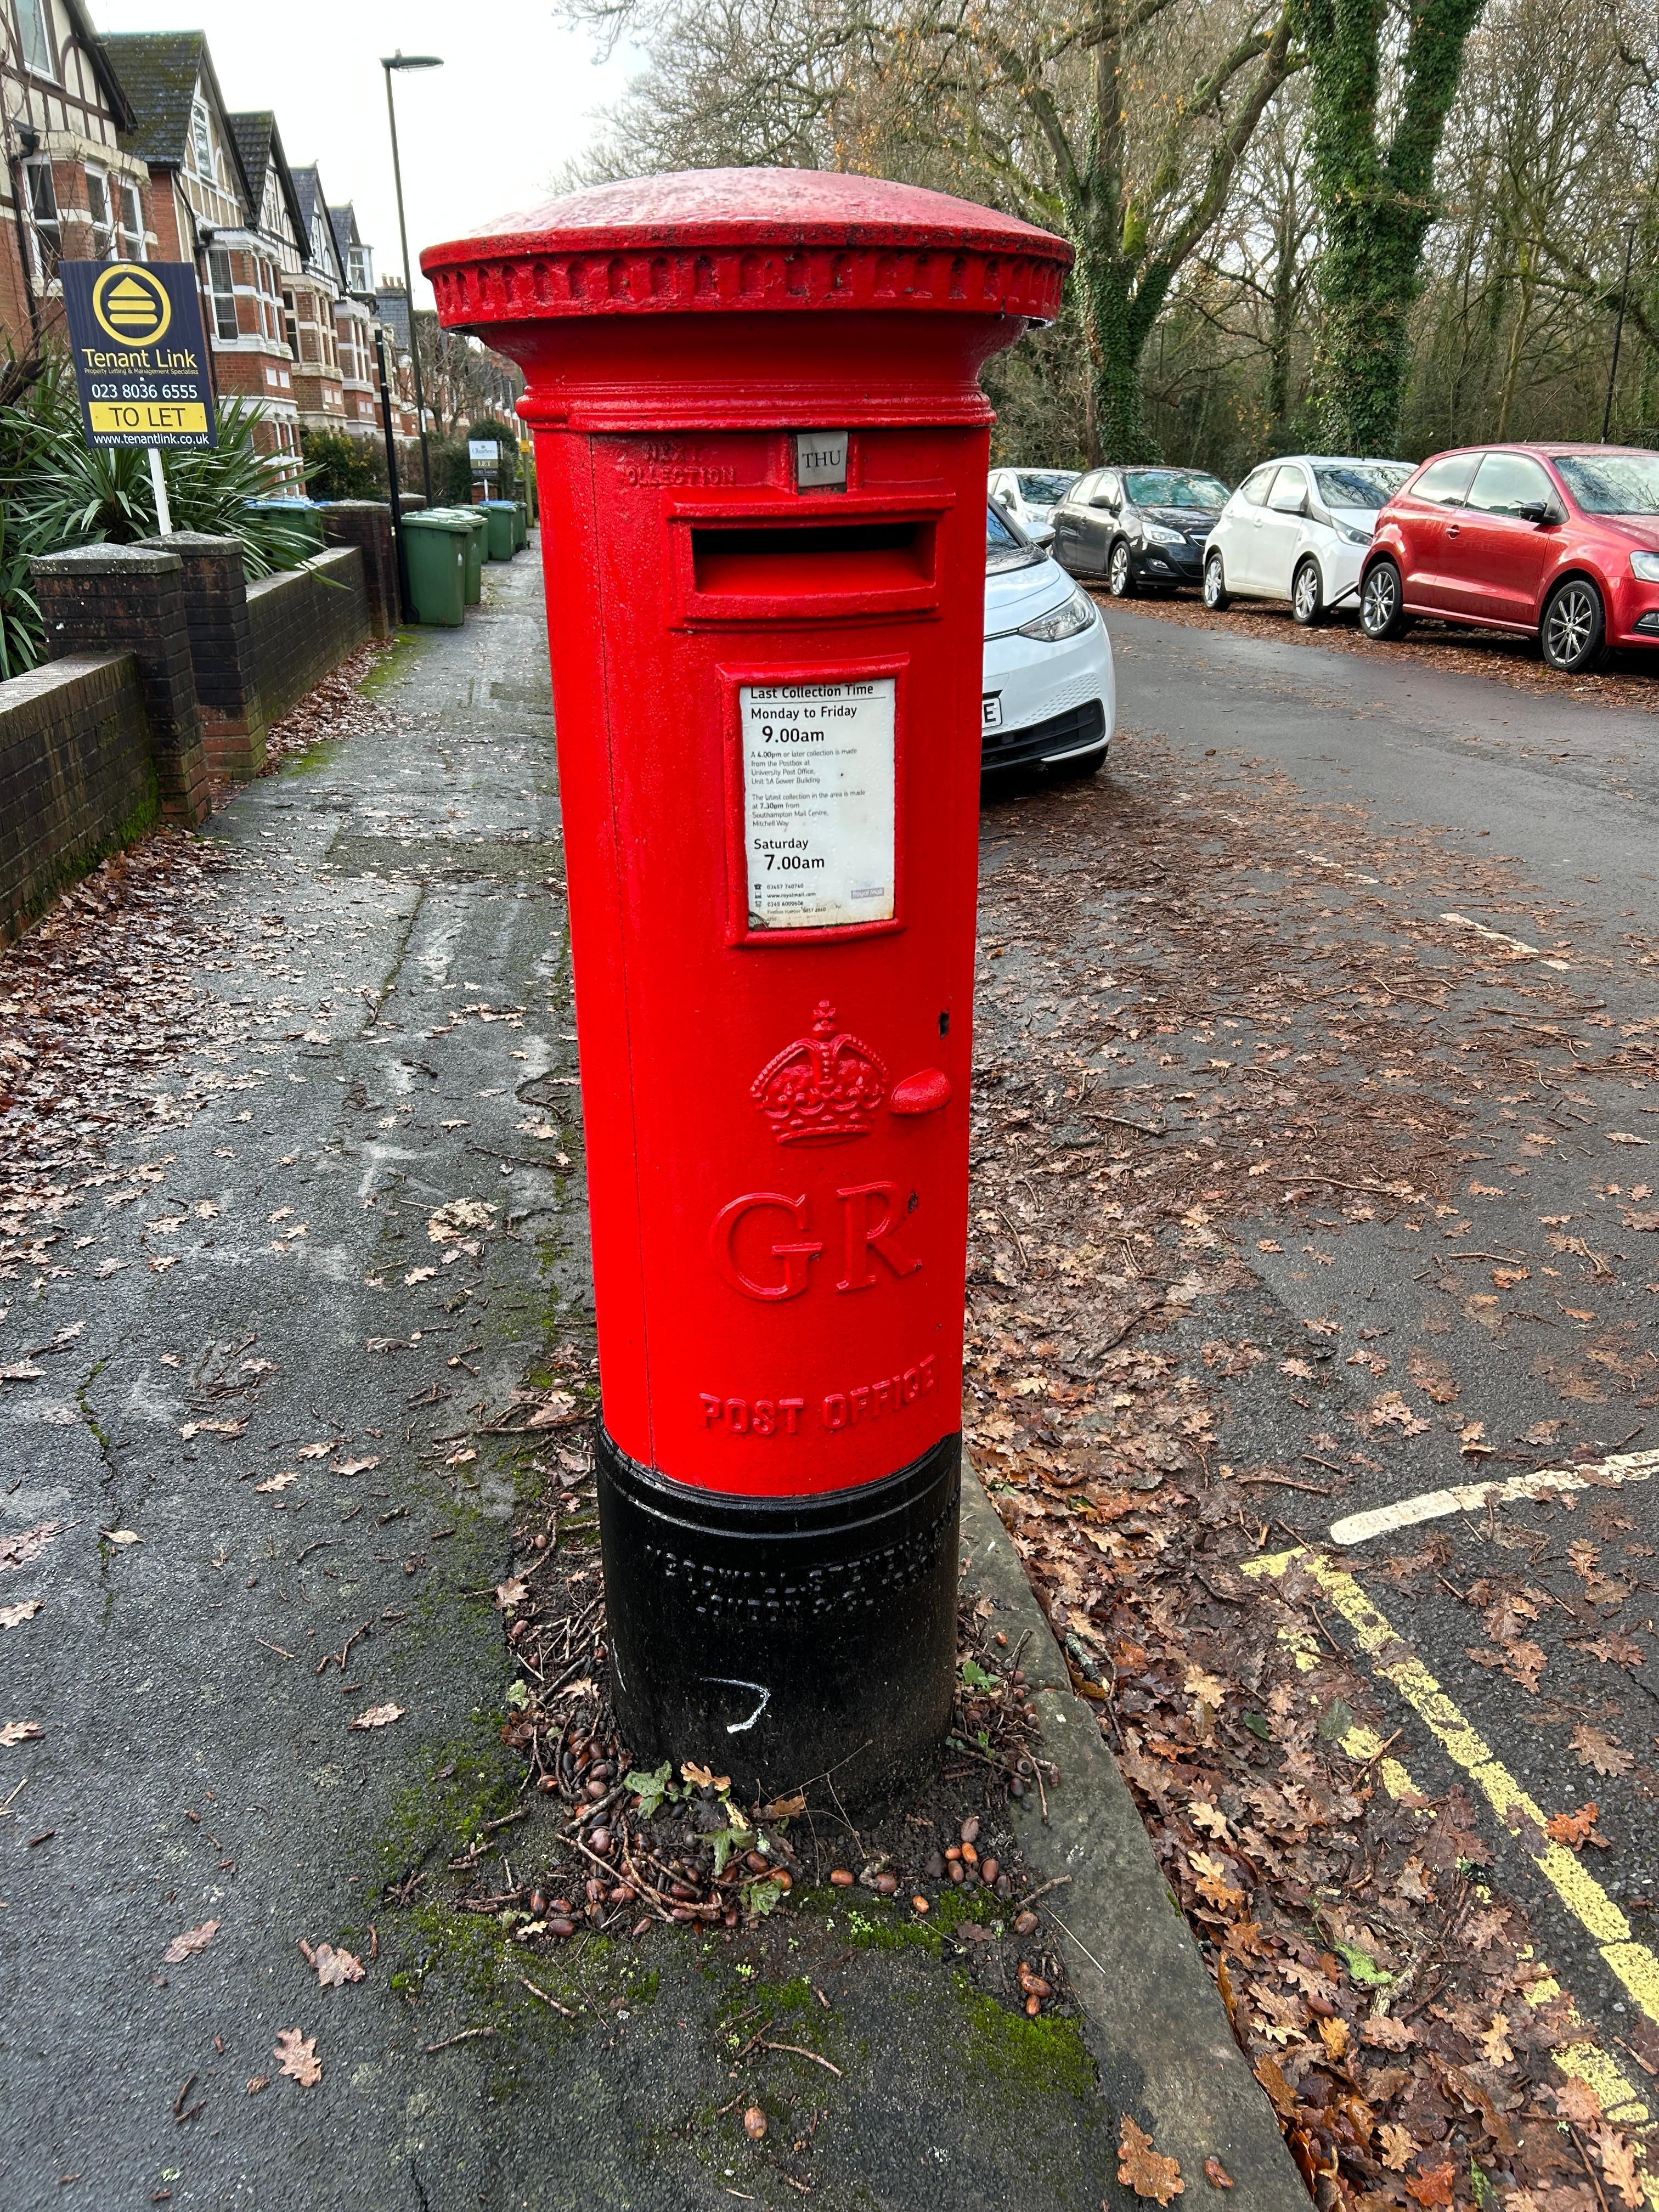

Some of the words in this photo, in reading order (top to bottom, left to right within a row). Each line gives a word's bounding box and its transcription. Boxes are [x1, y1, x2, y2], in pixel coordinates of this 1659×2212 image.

[81, 348, 150, 367] Tenant
[156, 348, 198, 368] Link
[92, 384, 118, 398] 023
[122, 384, 157, 398] 8036
[162, 384, 198, 398] 6555
[109, 407, 139, 427] TO
[147, 407, 185, 427] LET
[94, 433, 210, 444] www.tenantlink.co.uk
[802, 450, 842, 469] THU
[624, 465, 737, 487] OLLECTION
[751, 687, 777, 699] Last
[782, 685, 841, 698] Collection
[845, 684, 873, 696] Time
[751, 708, 799, 721] Monday
[804, 708, 816, 718] to
[821, 705, 857, 718] Friday
[762, 725, 824, 743] 9.00am
[751, 769, 781, 777] University
[752, 811, 792, 819] Southampton
[754, 837, 809, 850] Saturday
[764, 854, 825, 871] 7.00am
[699, 1392, 804, 1435] POST
[823, 1353, 935, 1430] OFFICE
